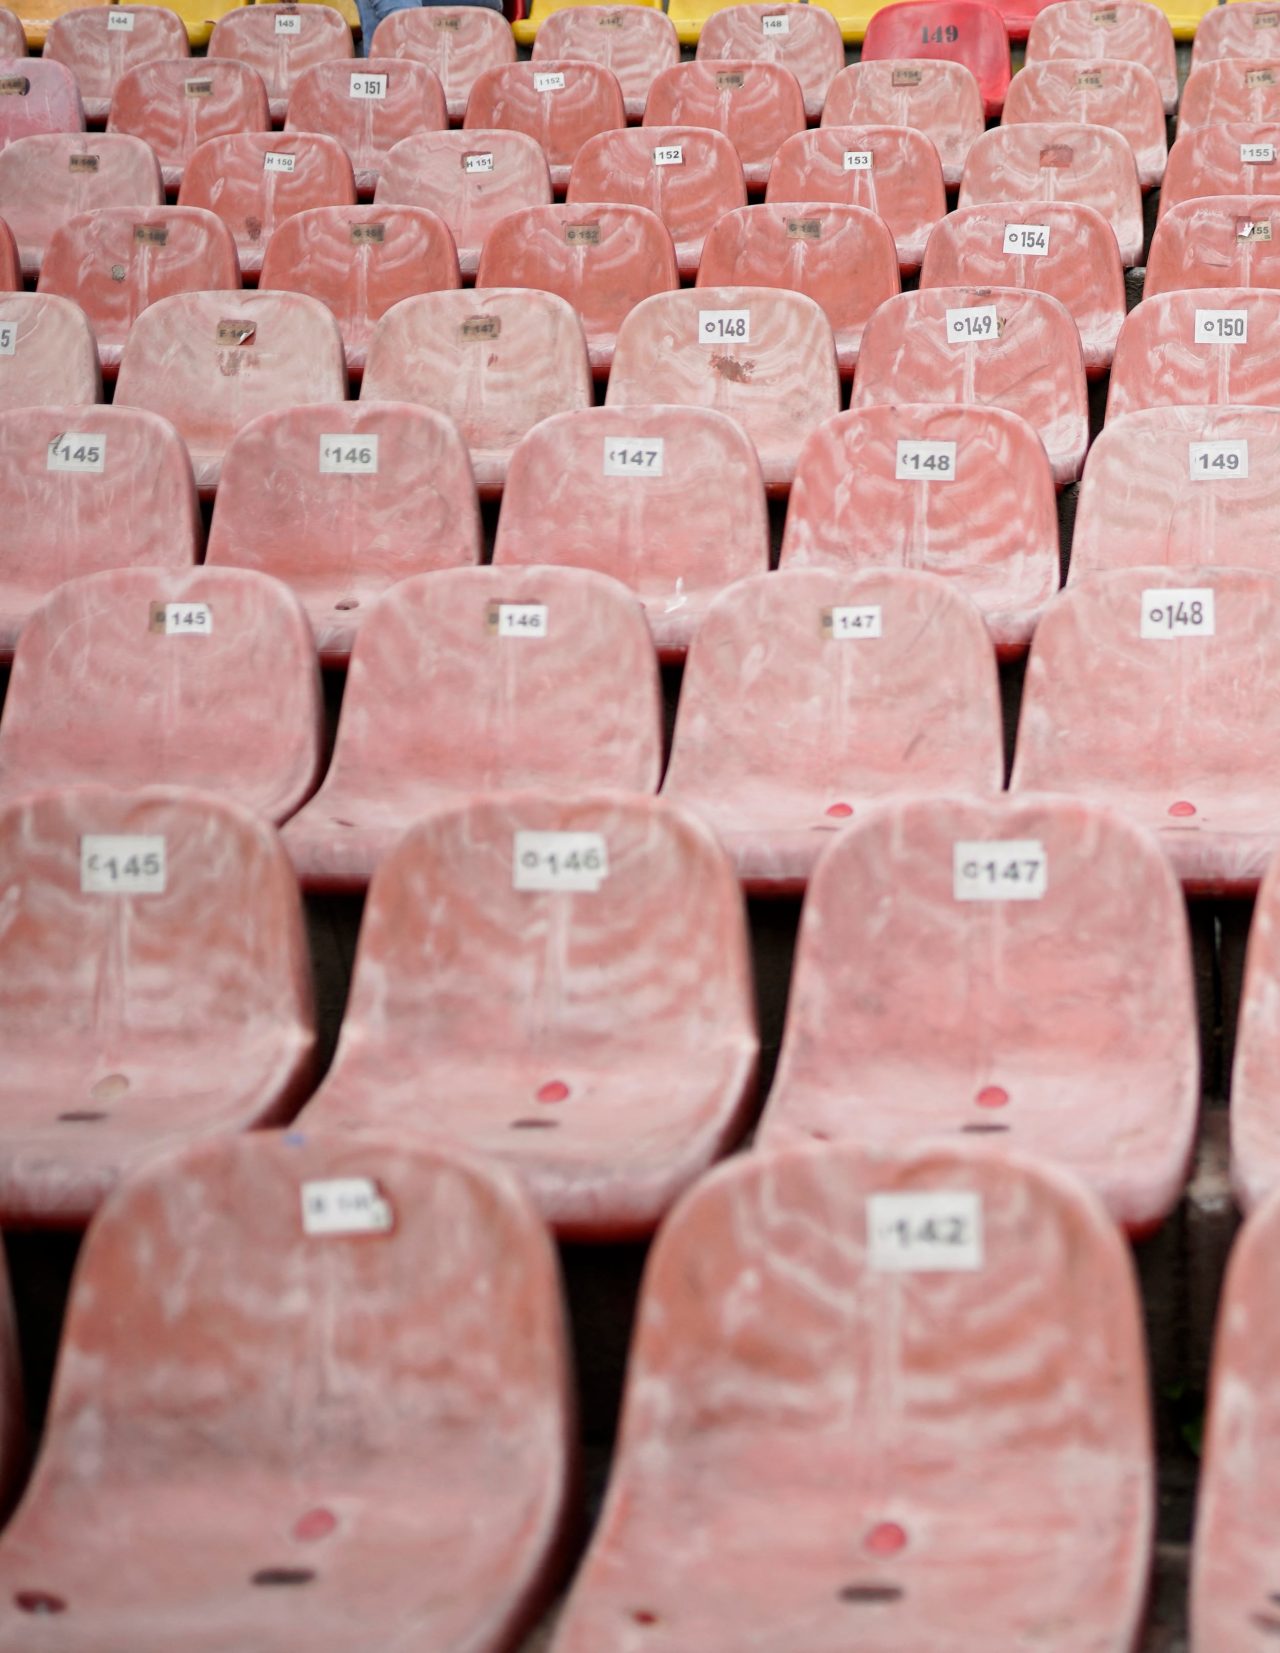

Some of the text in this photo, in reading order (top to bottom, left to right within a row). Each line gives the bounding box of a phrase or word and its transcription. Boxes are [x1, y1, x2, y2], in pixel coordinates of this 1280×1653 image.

[111, 16, 127, 24] 144
[278, 20, 294, 28] 145
[765, 20, 782, 29] 148
[921, 25, 958, 44] 149
[546, 77, 560, 85] 152
[365, 81, 380, 95] 151
[659, 149, 680, 160] 152
[1248, 148, 1269, 157] 155
[278, 158, 292, 167] 150
[476, 158, 491, 167] 151
[847, 155, 868, 165] 153
[1021, 231, 1045, 249] 154
[718, 318, 746, 338] 148
[964, 315, 991, 336] 149
[1216, 317, 1244, 337] 150
[1198, 453, 1240, 470] 149
[171, 610, 206, 625] 145
[508, 614, 541, 627] 146
[841, 614, 875, 629] 147
[1166, 601, 1204, 630] 148
